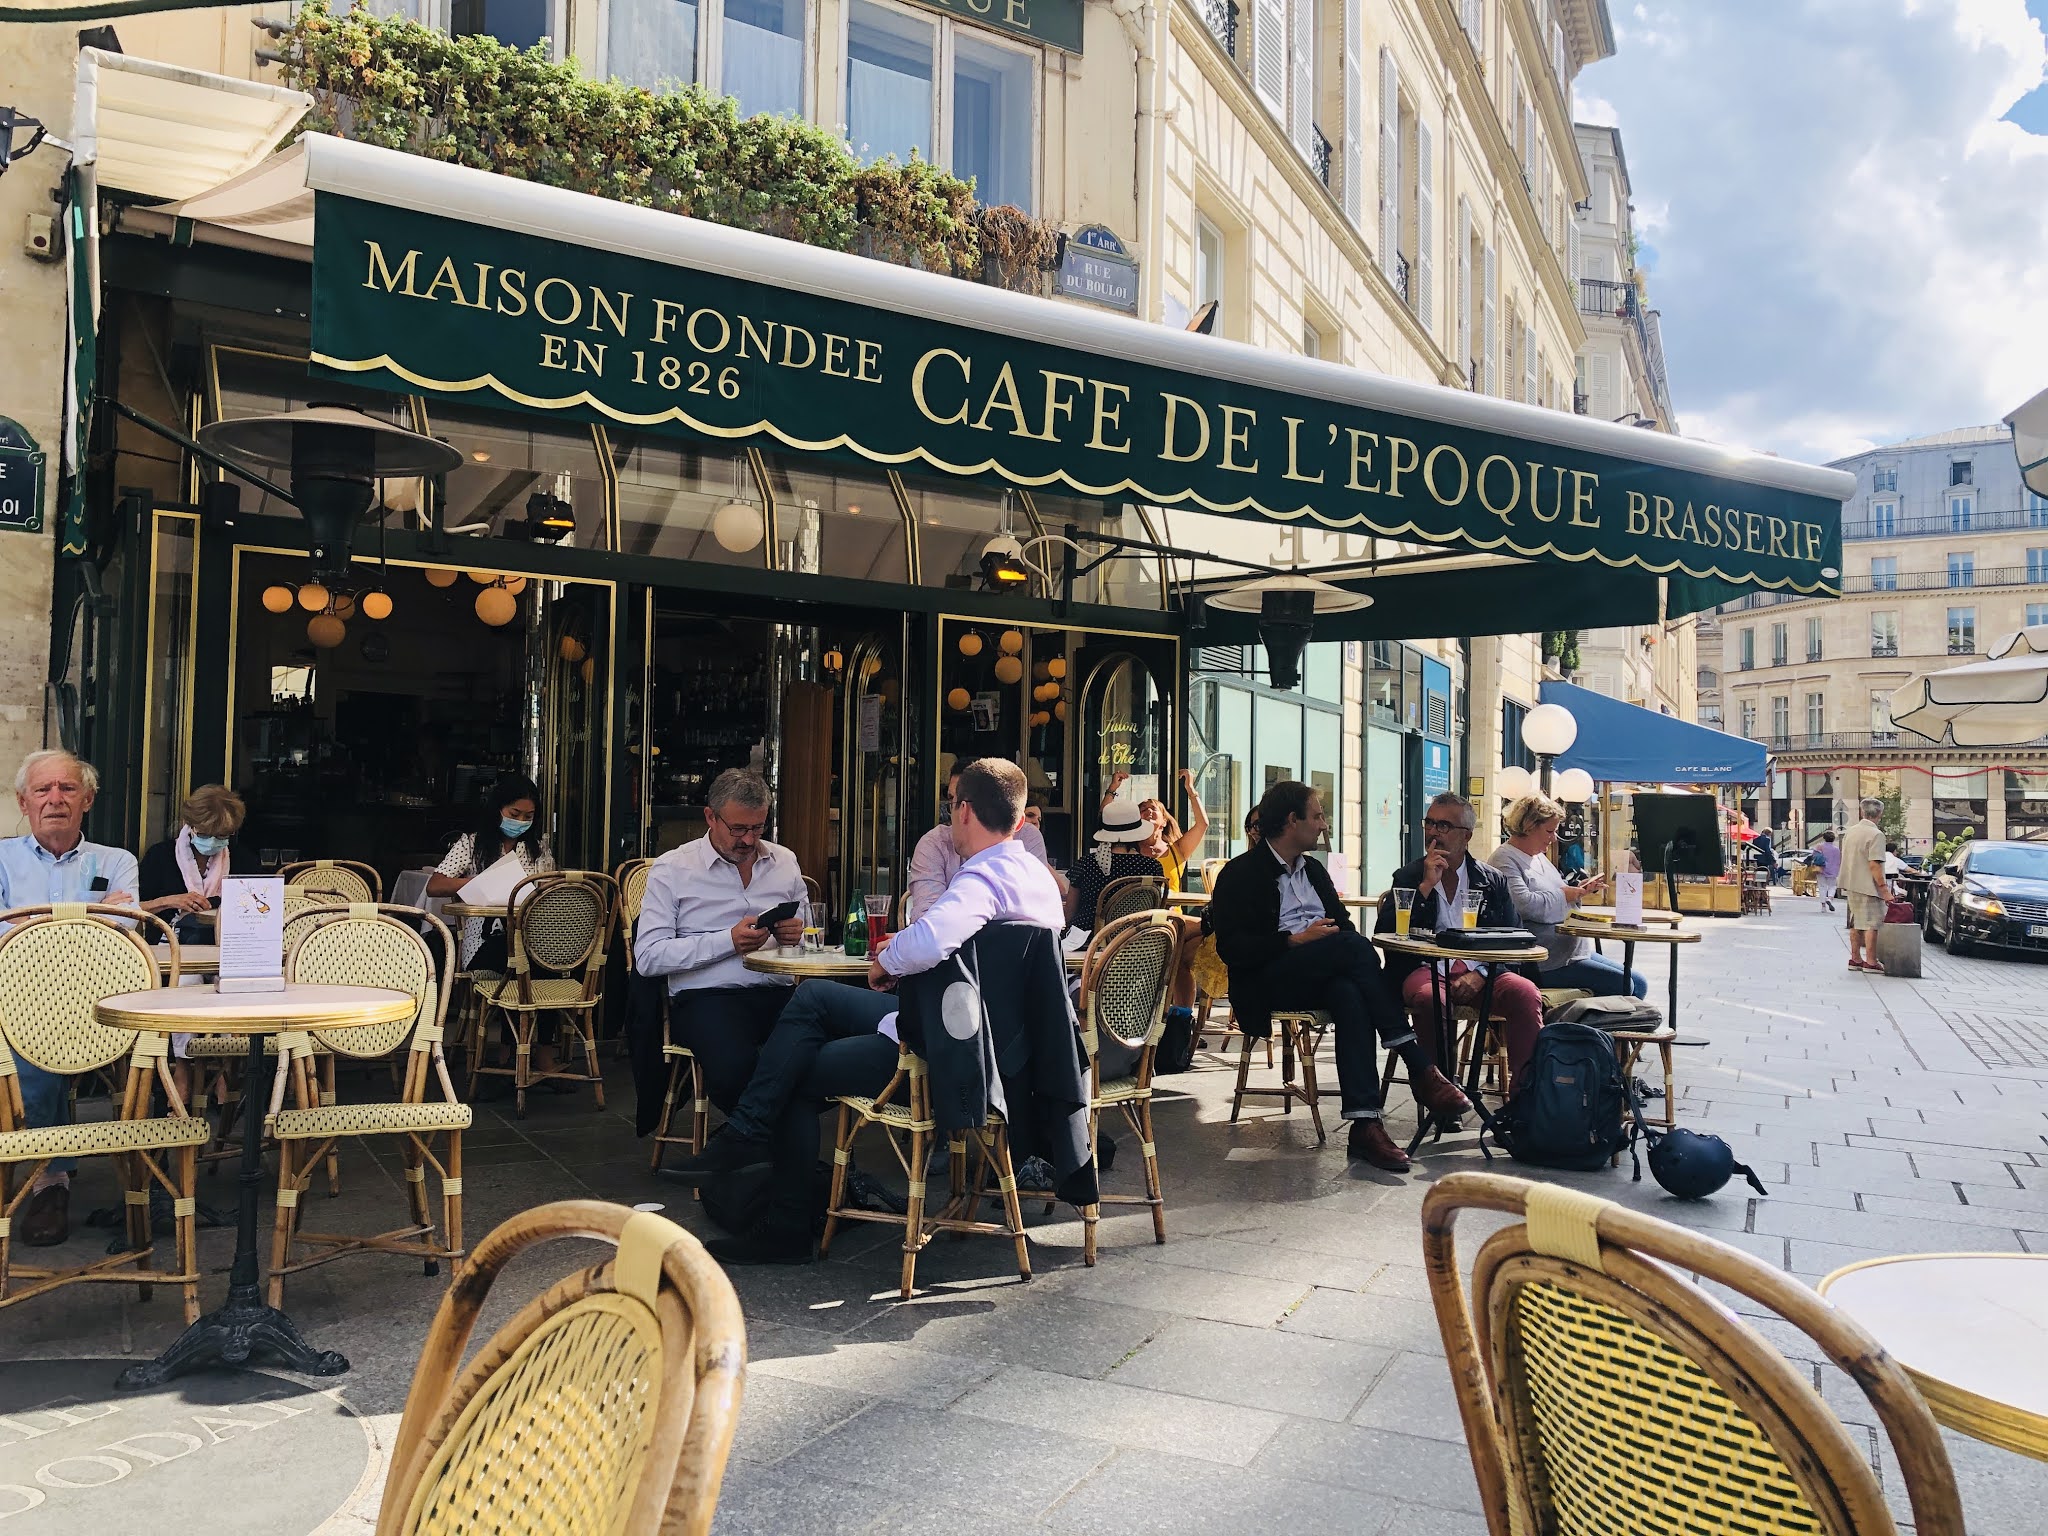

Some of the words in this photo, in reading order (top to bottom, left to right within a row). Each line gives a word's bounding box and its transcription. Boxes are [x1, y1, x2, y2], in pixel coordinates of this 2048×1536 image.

[1066, 274, 1083, 288] DU
[1086, 279, 1127, 299] BOULOI
[1084, 262, 1111, 279] RUE
[361, 240, 634, 337] MAISON
[649, 298, 883, 384] FONDEE
[538, 333, 608, 377] EN
[630, 350, 741, 399] 1826
[911, 347, 1131, 453] CAFE
[1157, 392, 1259, 473] DE
[1281, 415, 1600, 528] L'EPOQUE
[1625, 490, 1823, 562] BRASSERIE
